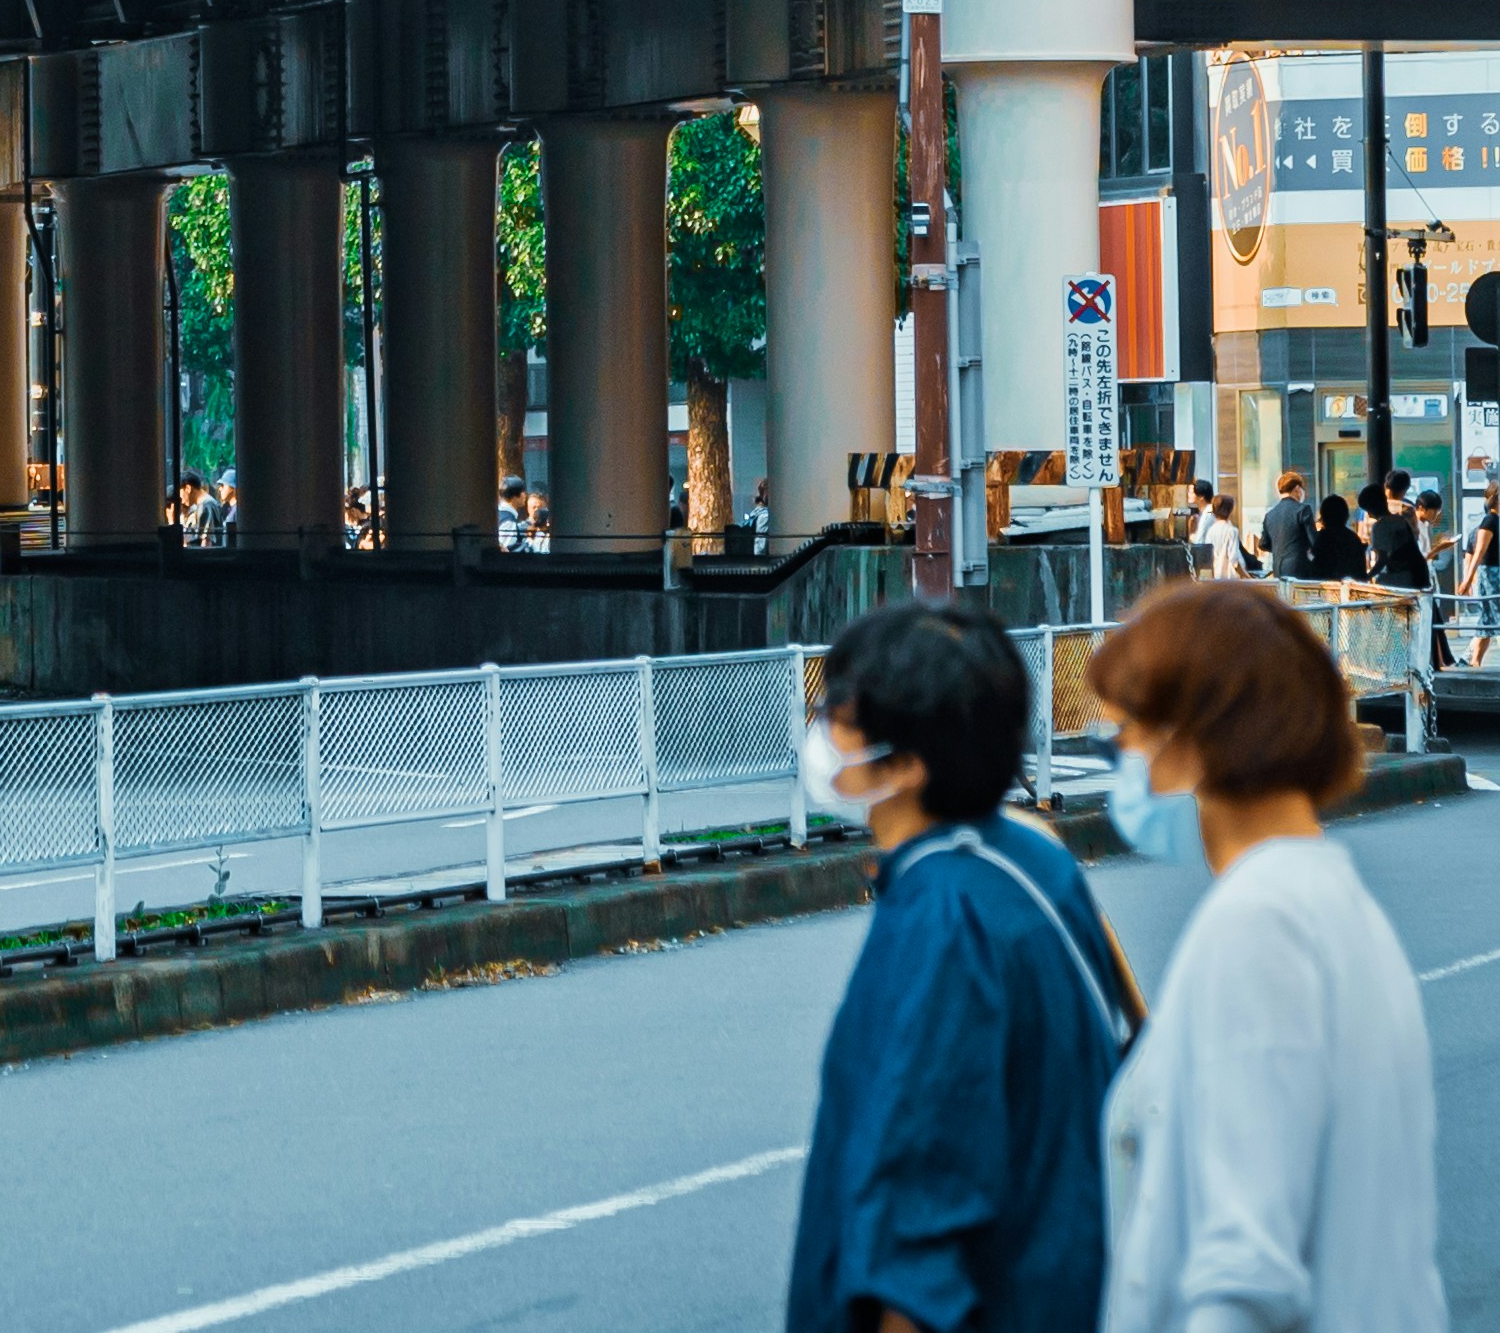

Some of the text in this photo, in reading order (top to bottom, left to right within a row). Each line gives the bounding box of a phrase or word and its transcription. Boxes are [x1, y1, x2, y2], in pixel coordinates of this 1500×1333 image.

[1218, 99, 1266, 199] No.1
[1331, 145, 1500, 174] 買価格!!
[1096, 328, 1114, 482] この先左折できません
